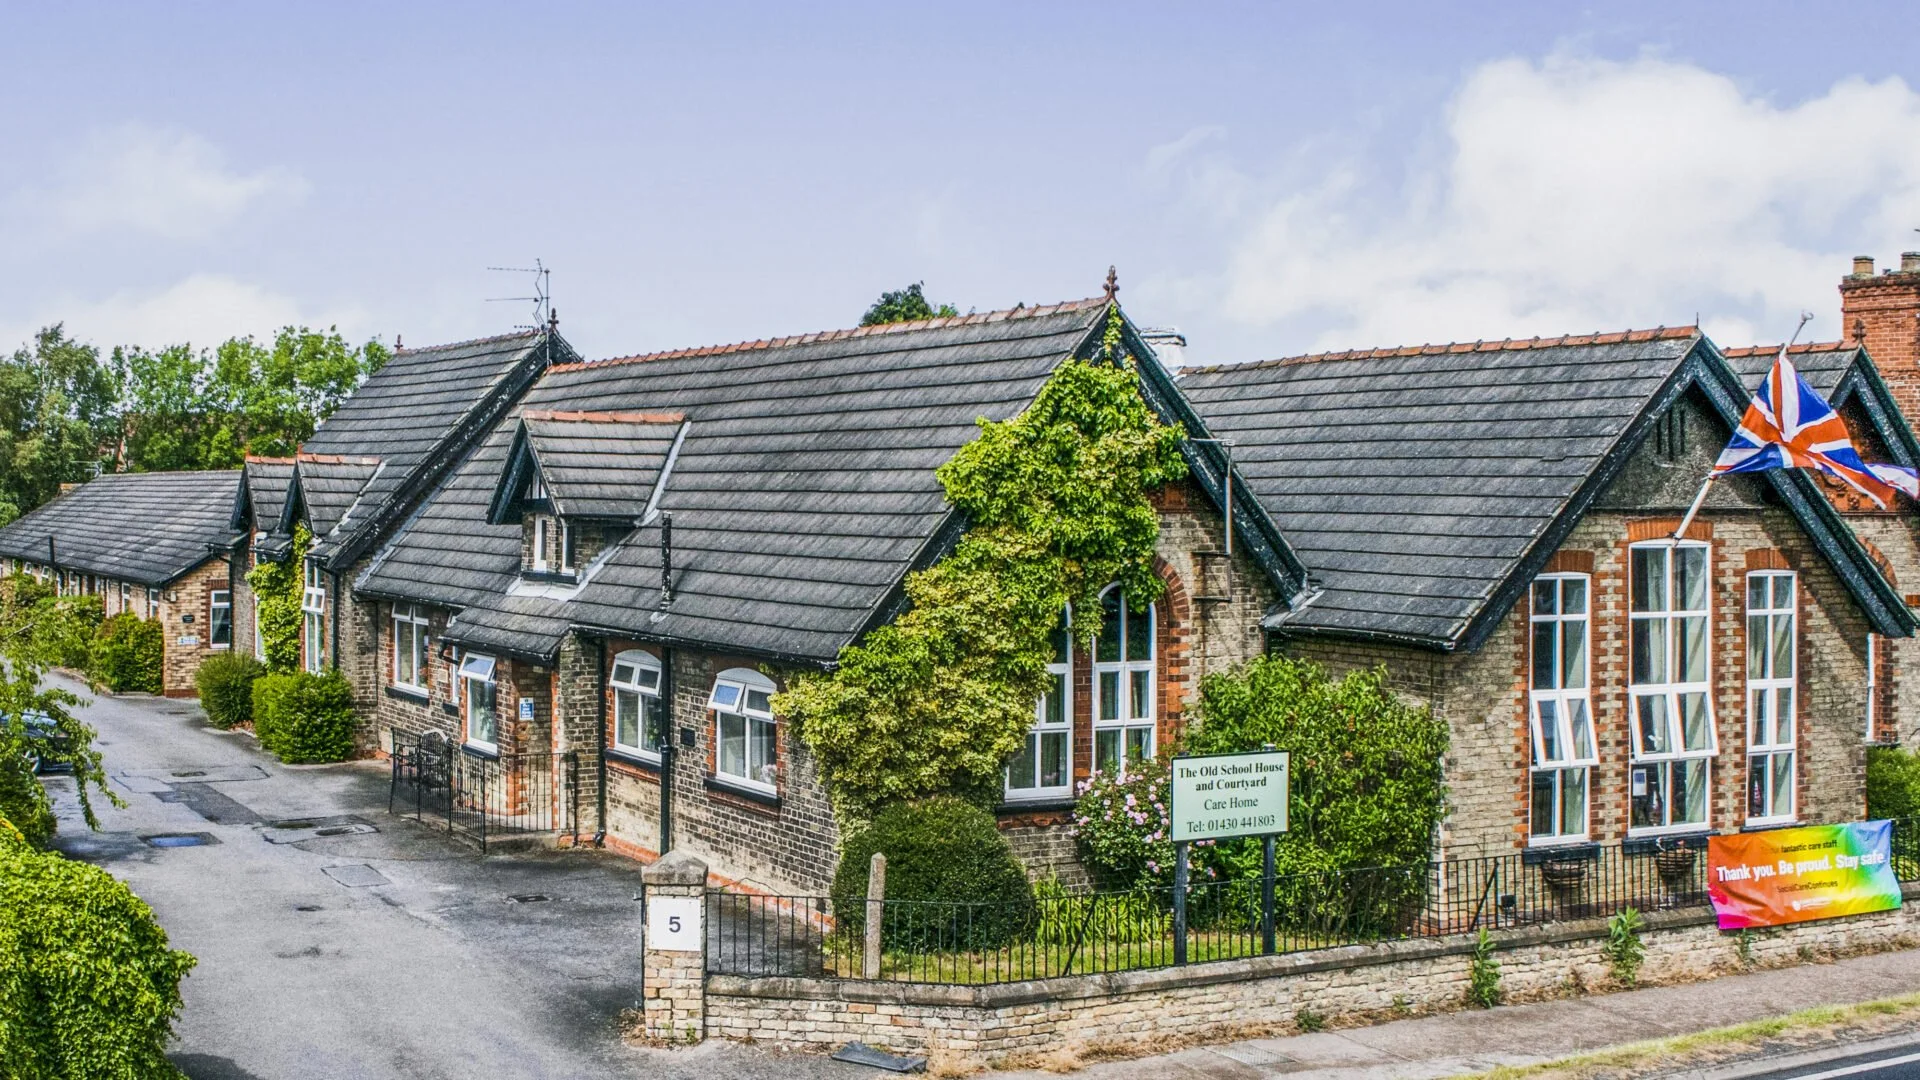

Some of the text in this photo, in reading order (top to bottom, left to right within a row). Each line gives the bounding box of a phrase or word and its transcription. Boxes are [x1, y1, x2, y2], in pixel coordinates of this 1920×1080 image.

[1179, 762, 1284, 778] The Old School House
[1196, 776, 1267, 791] and Courtyard
[1204, 797, 1258, 810] Care Home
[1187, 814, 1275, 833] Tel: 01430 441803
[1781, 843, 1806, 853] fantastic
[1808, 842, 1821, 850] care
[1823, 840, 1837, 849] staff
[1716, 850, 1884, 882] Thank you. Be proud. Stay safe
[669, 916, 681, 933] 5
